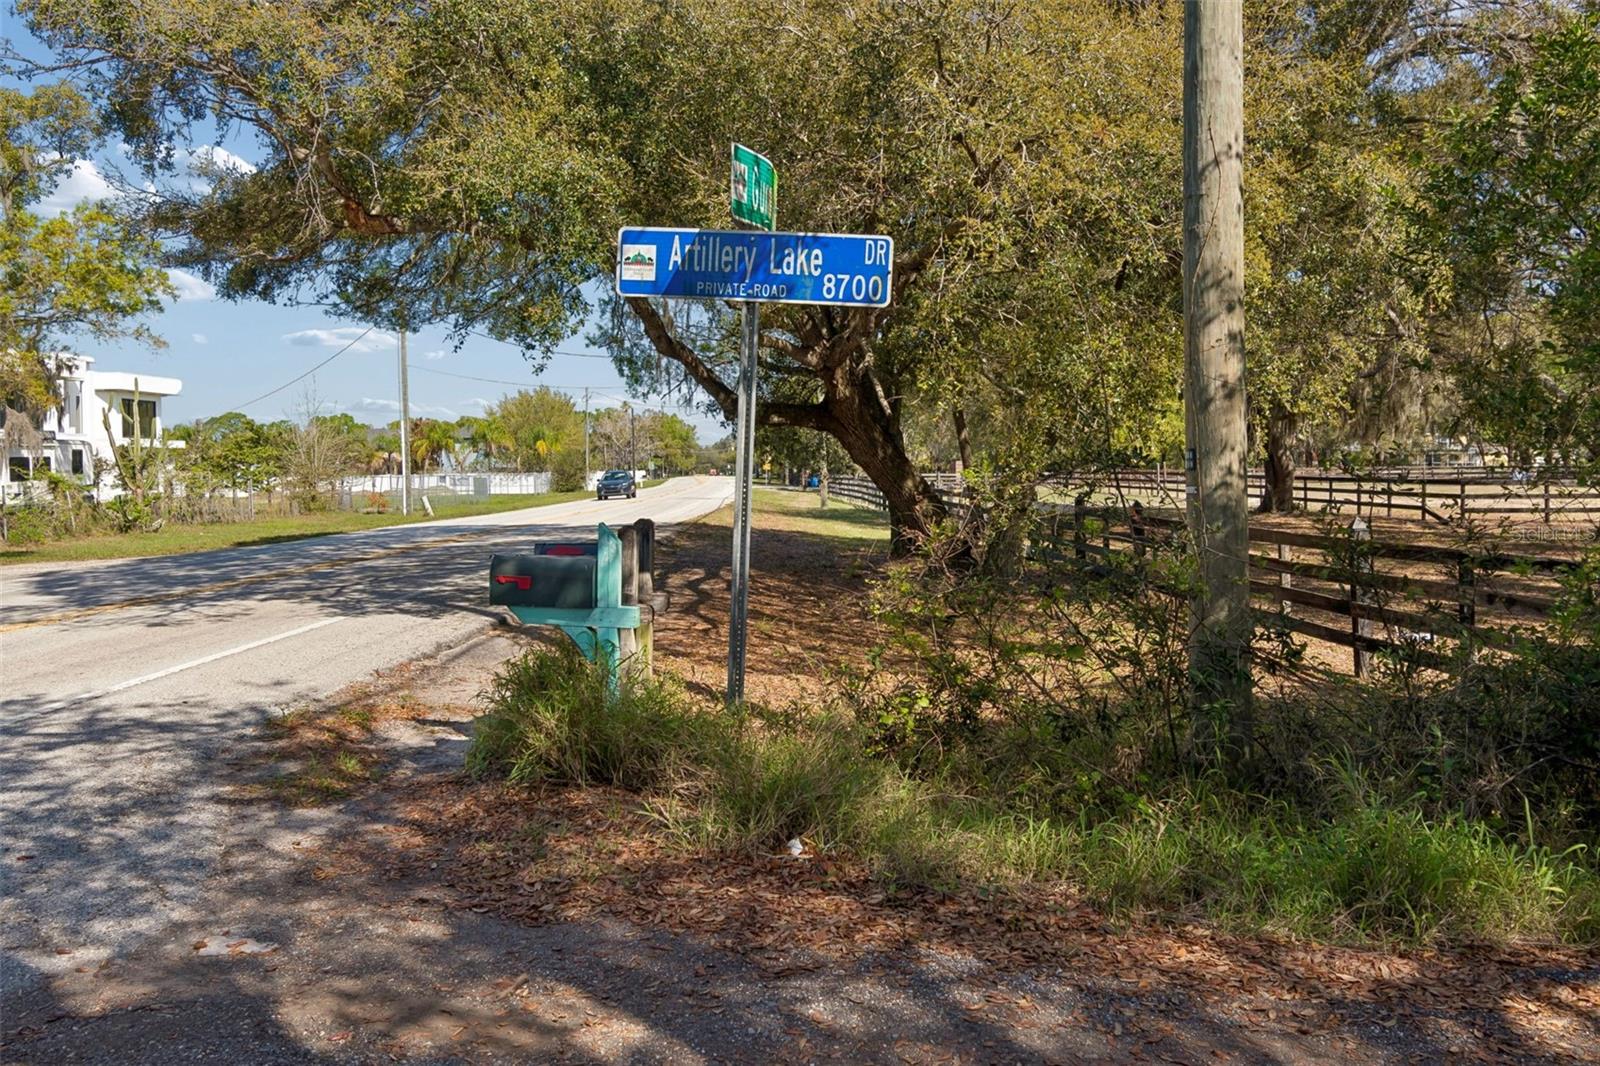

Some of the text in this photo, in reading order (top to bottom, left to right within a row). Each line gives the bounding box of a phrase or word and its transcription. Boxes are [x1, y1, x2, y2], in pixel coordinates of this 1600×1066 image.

[668, 234, 887, 283] Artillery Lake DR
[696, 281, 787, 298] PRIVATE ROAD
[822, 273, 882, 301] 8700
